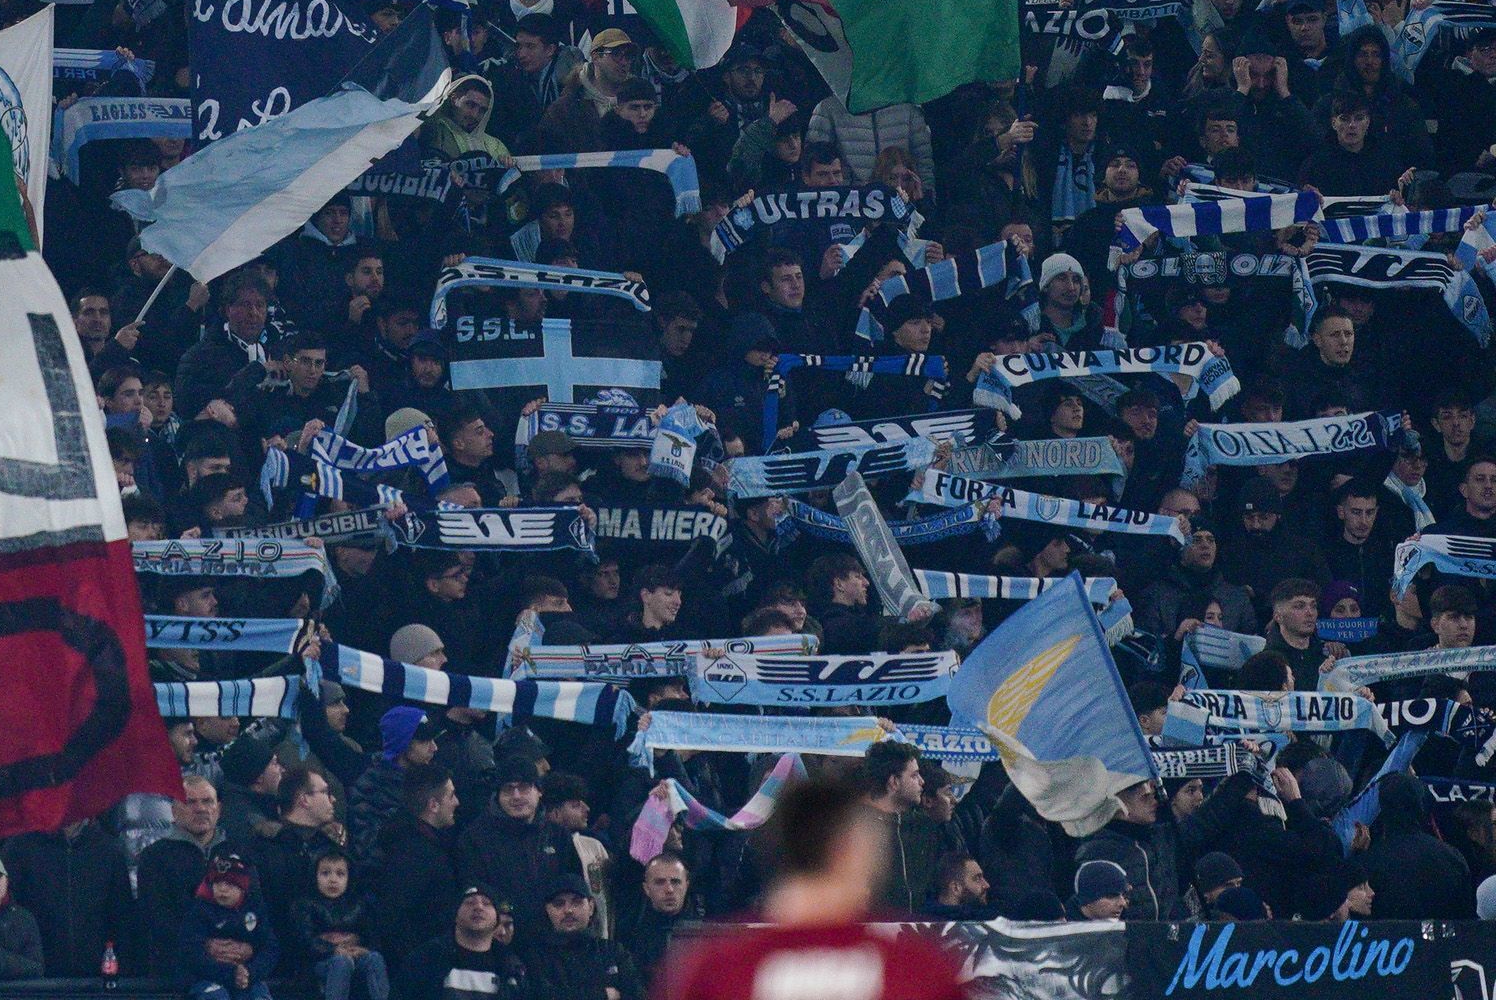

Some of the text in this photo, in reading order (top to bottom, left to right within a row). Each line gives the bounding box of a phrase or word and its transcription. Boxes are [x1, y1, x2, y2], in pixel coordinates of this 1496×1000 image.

[90, 102, 147, 122] EAGLES
[753, 189, 886, 225] ULTRAS
[1003, 343, 1206, 376] CURVA NORD
[540, 412, 597, 437] S.S.
[1023, 440, 1103, 469] NORD
[1076, 500, 1150, 526] LAZIO
[202, 560, 278, 576] NOSTRA
[584, 661, 657, 676] PATRIA
[1295, 696, 1354, 722] LAZIO
[1165, 918, 1415, 996] Marcolino
